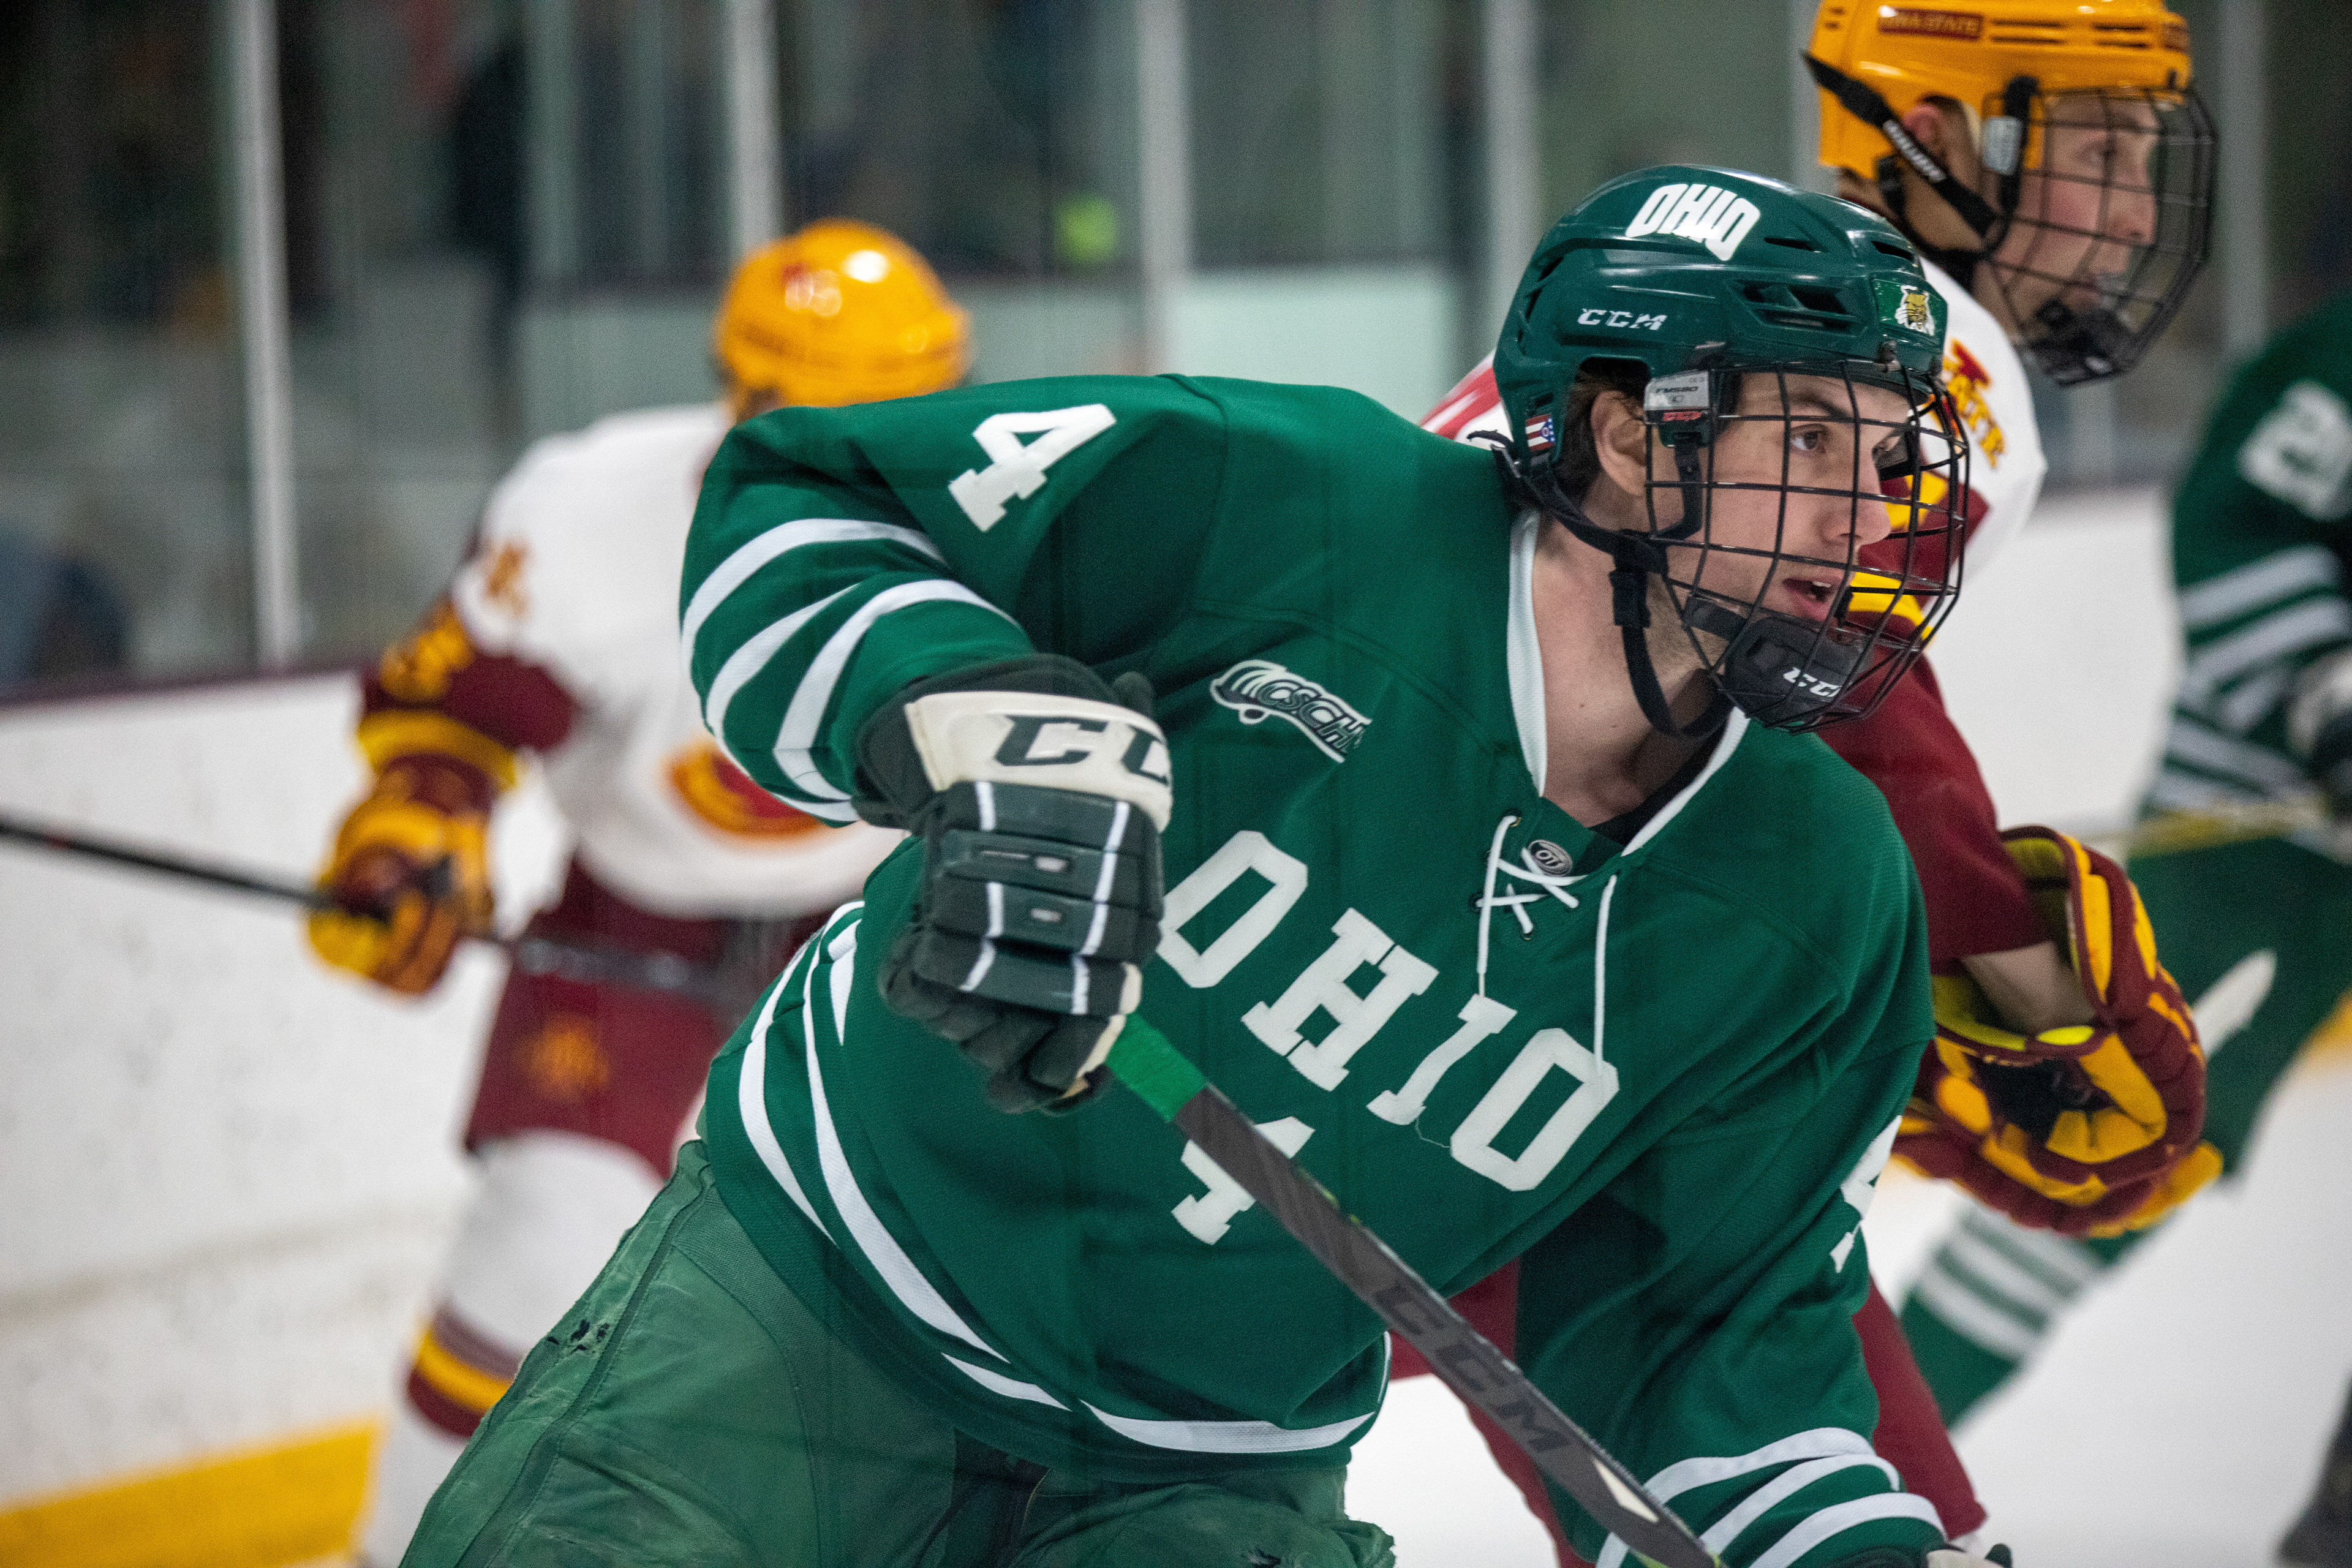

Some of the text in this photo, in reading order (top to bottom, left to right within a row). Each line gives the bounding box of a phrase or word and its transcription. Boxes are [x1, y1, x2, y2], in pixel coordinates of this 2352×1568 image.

[1625, 184, 1760, 261] OHIO
[1577, 309, 1667, 330] CCM
[948, 404, 1116, 532] 4
[1156, 831, 1619, 1191] OHIO
[1374, 1283, 1569, 1453] CCM
